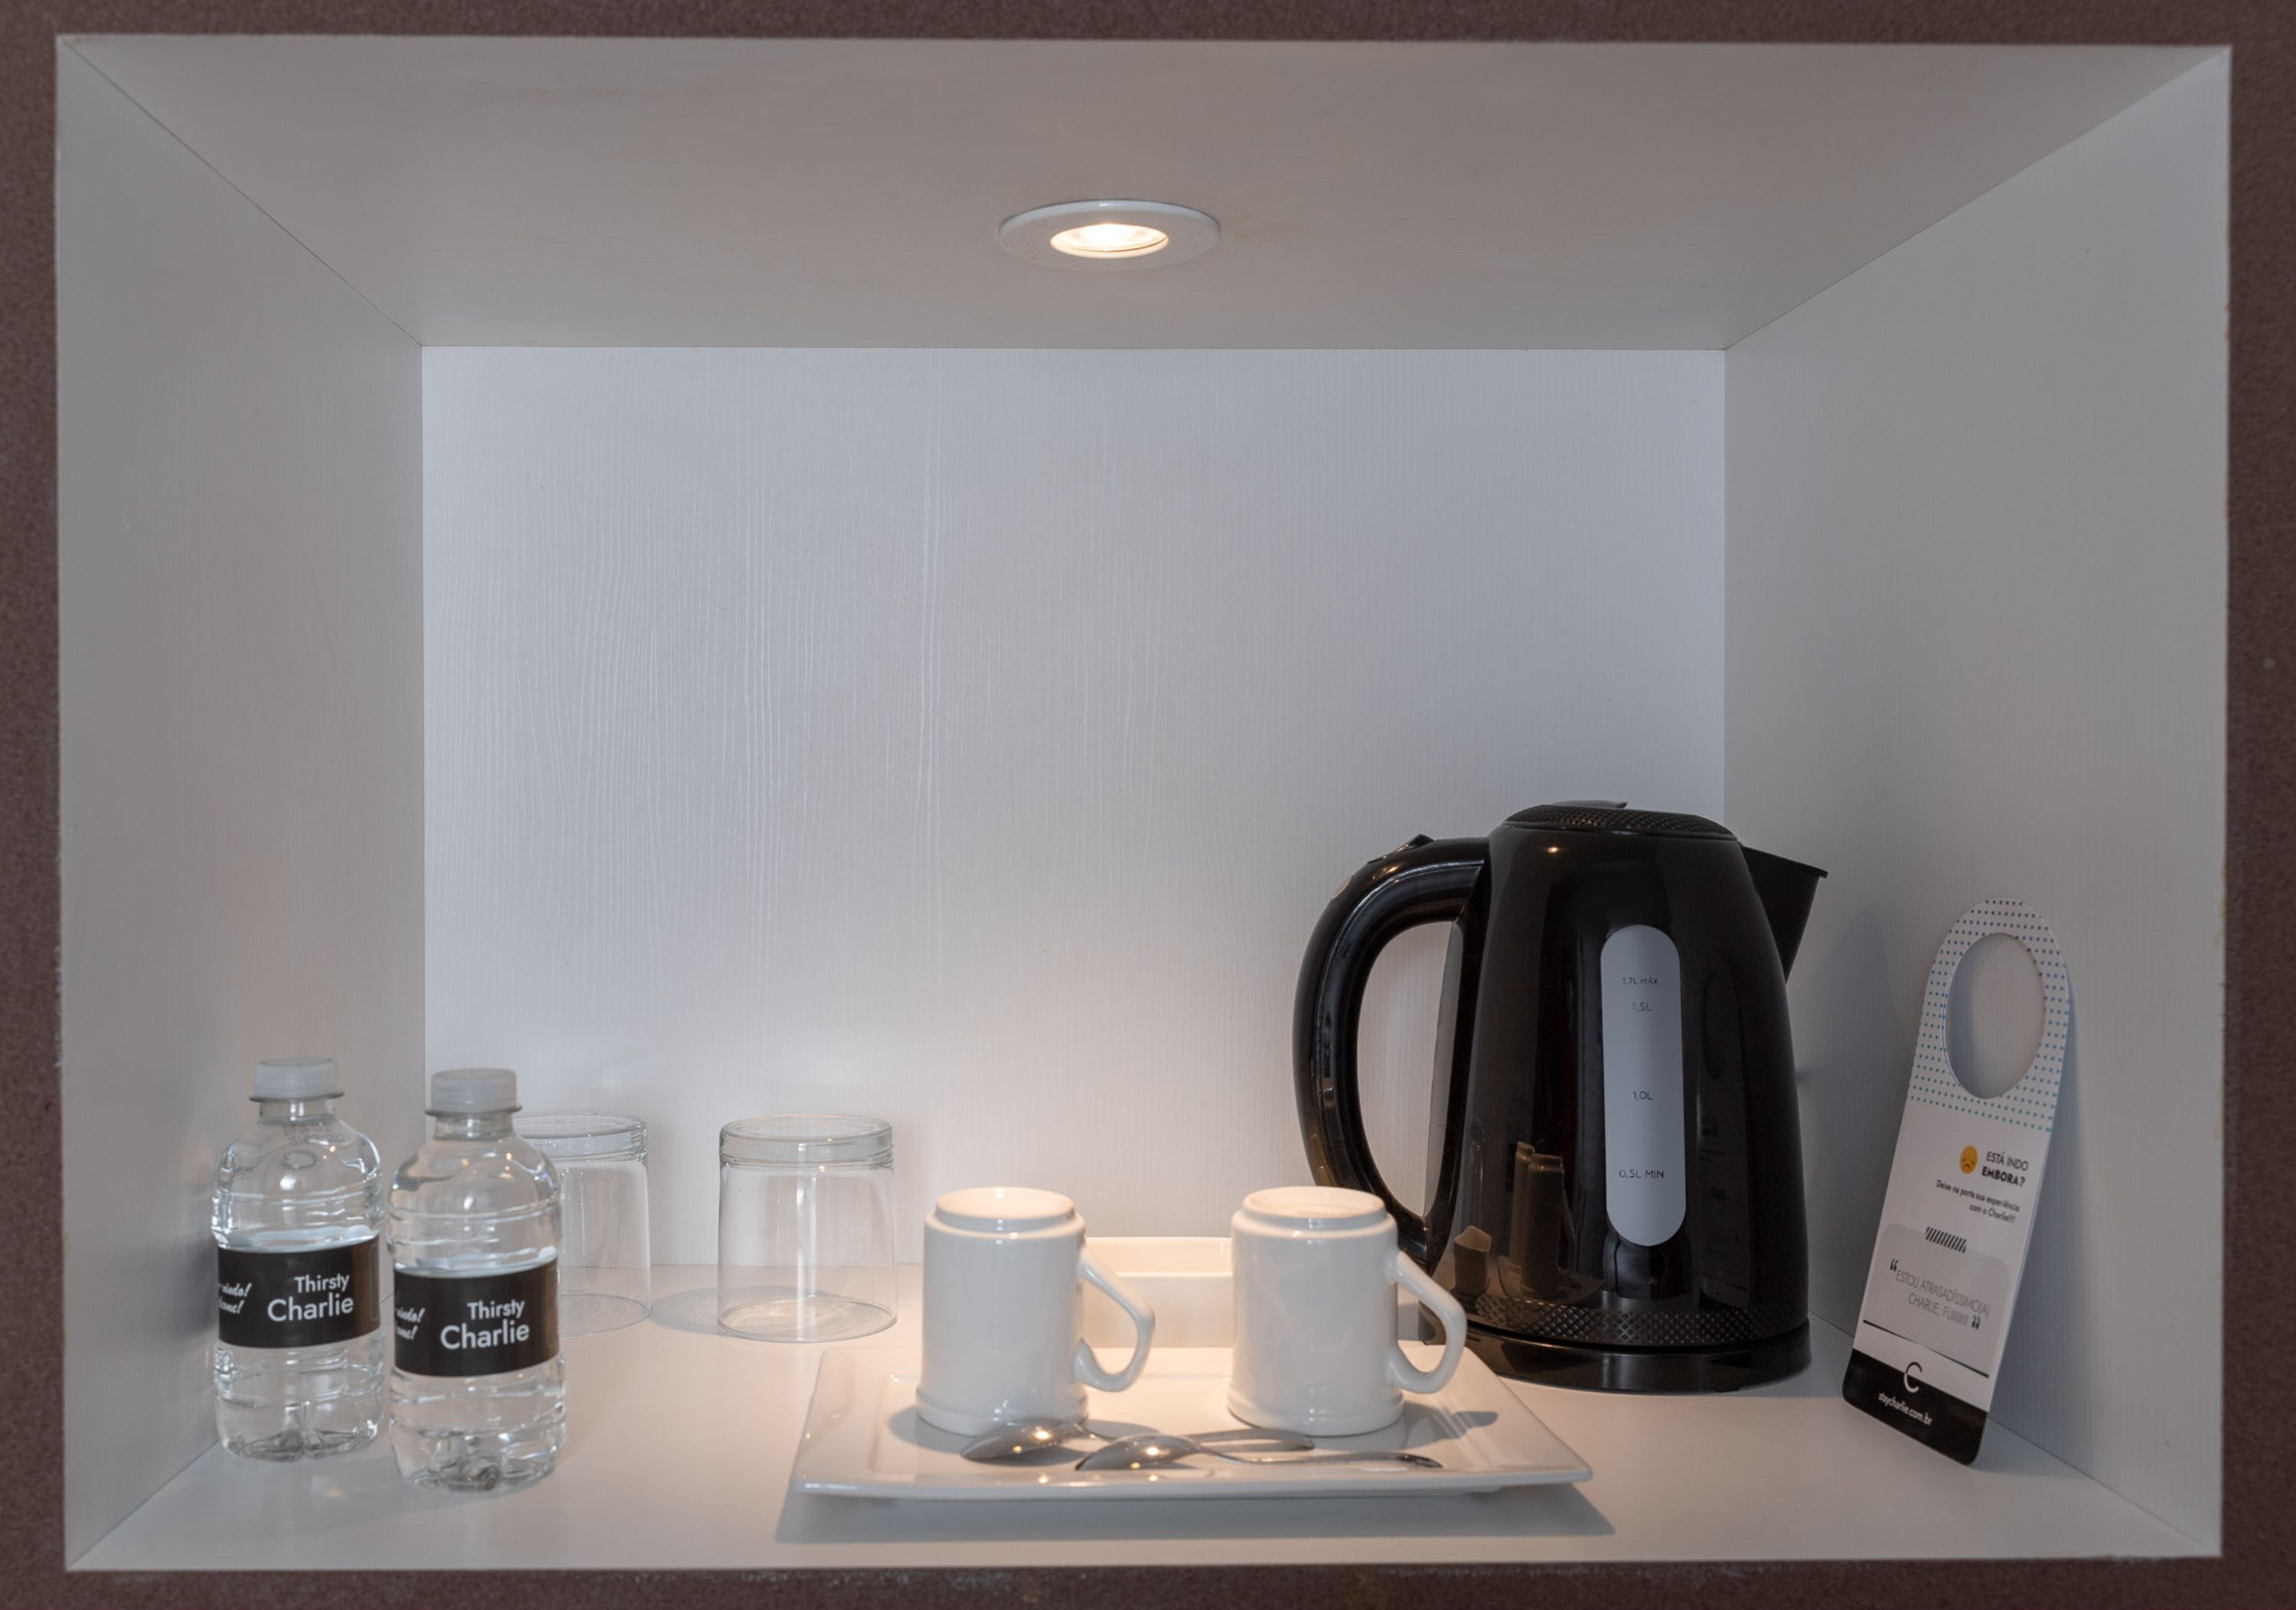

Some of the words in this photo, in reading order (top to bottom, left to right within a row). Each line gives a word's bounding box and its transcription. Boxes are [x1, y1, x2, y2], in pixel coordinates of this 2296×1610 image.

[1986, 1151, 2004, 1165] ESTÁ
[2006, 1156, 2029, 1172] INDO
[1645, 1169, 1665, 1179] MIN
[1981, 1166, 2026, 1187] EMBORA?
[294, 1273, 350, 1293] Thirsty
[267, 1292, 354, 1322] Charlie
[467, 1299, 525, 1320] Thirsty
[440, 1318, 530, 1350] Charlie
